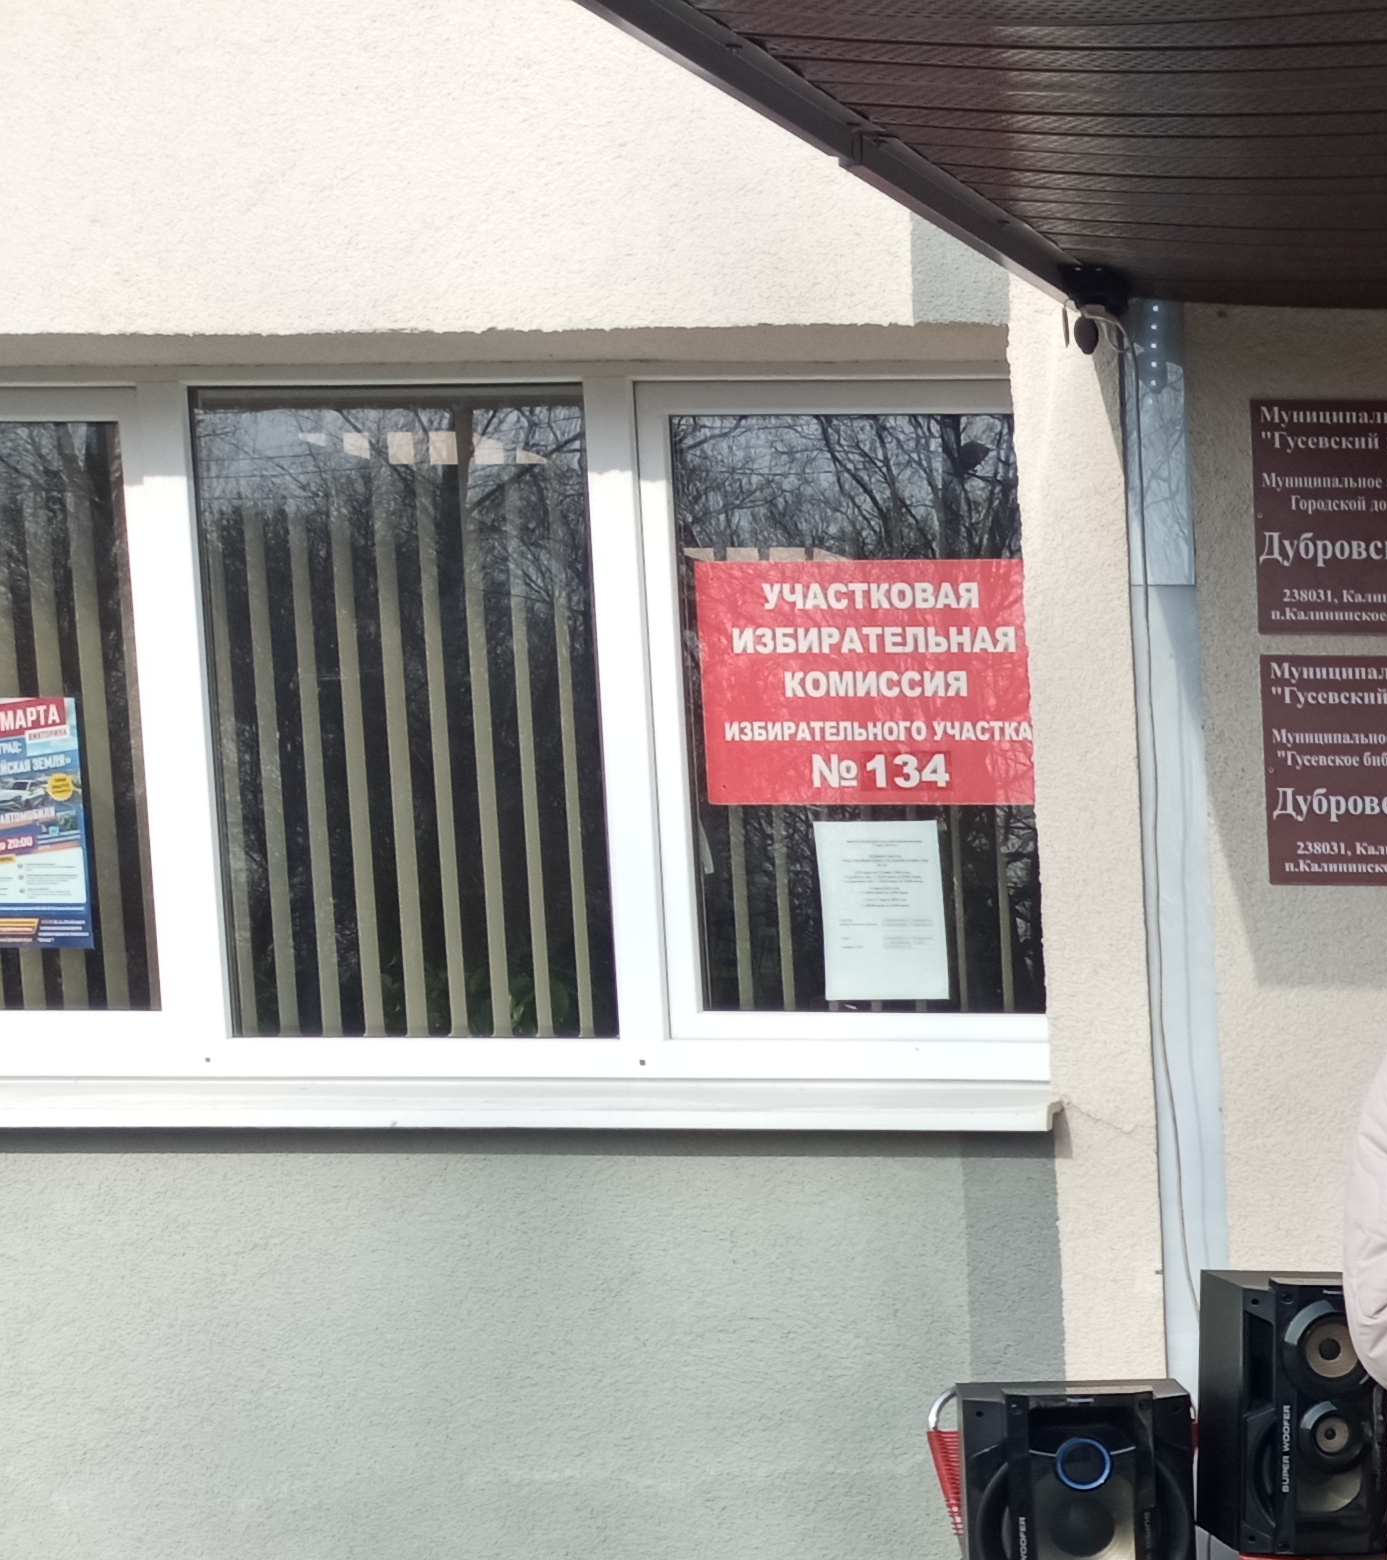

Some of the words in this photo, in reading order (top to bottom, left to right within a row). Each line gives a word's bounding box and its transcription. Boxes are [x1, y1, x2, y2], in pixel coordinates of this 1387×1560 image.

[1261, 431, 1380, 452] "Гусевский
[1262, 472, 1382, 492] Муниципальное
[1291, 495, 1366, 514] Городской
[762, 582, 979, 610] УЧАСТКОВАЯ
[1283, 589, 1338, 604] 238031,
[732, 626, 1016, 654] ИЗБИРАТЕЛЬНАЯ
[784, 670, 968, 698] КОМИССИЯ
[0, 704, 61, 732] МАРТА
[724, 721, 927, 742] ИЗБИРАТЕЛЬНОГО
[933, 721, 1033, 742] УЧАСТКА
[811, 753, 858, 788] №
[865, 753, 950, 788] 134
[1277, 751, 1359, 769] "Гусевское
[7, 836, 33, 850] 20:00
[1296, 841, 1351, 857] 238031,
[1282, 1404, 1291, 1452] WOOFER
[1282, 1455, 1290, 1493] SUPER
